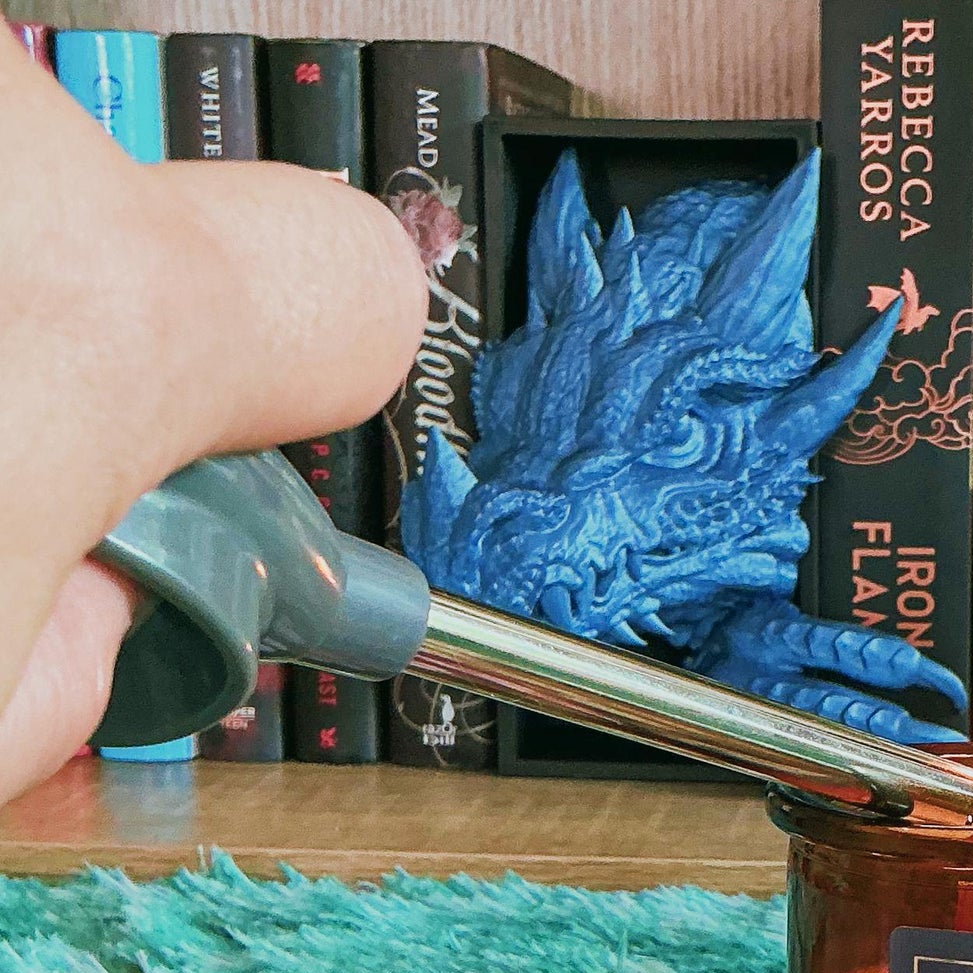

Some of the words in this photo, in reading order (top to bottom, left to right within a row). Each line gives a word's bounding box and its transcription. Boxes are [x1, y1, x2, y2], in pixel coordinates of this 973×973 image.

[198, 66, 223, 158] WHITE
[415, 88, 440, 168] MEAD
[859, 36, 894, 223] YARROS
[899, 19, 936, 243] REBECCA
[896, 546, 935, 649] IRON
